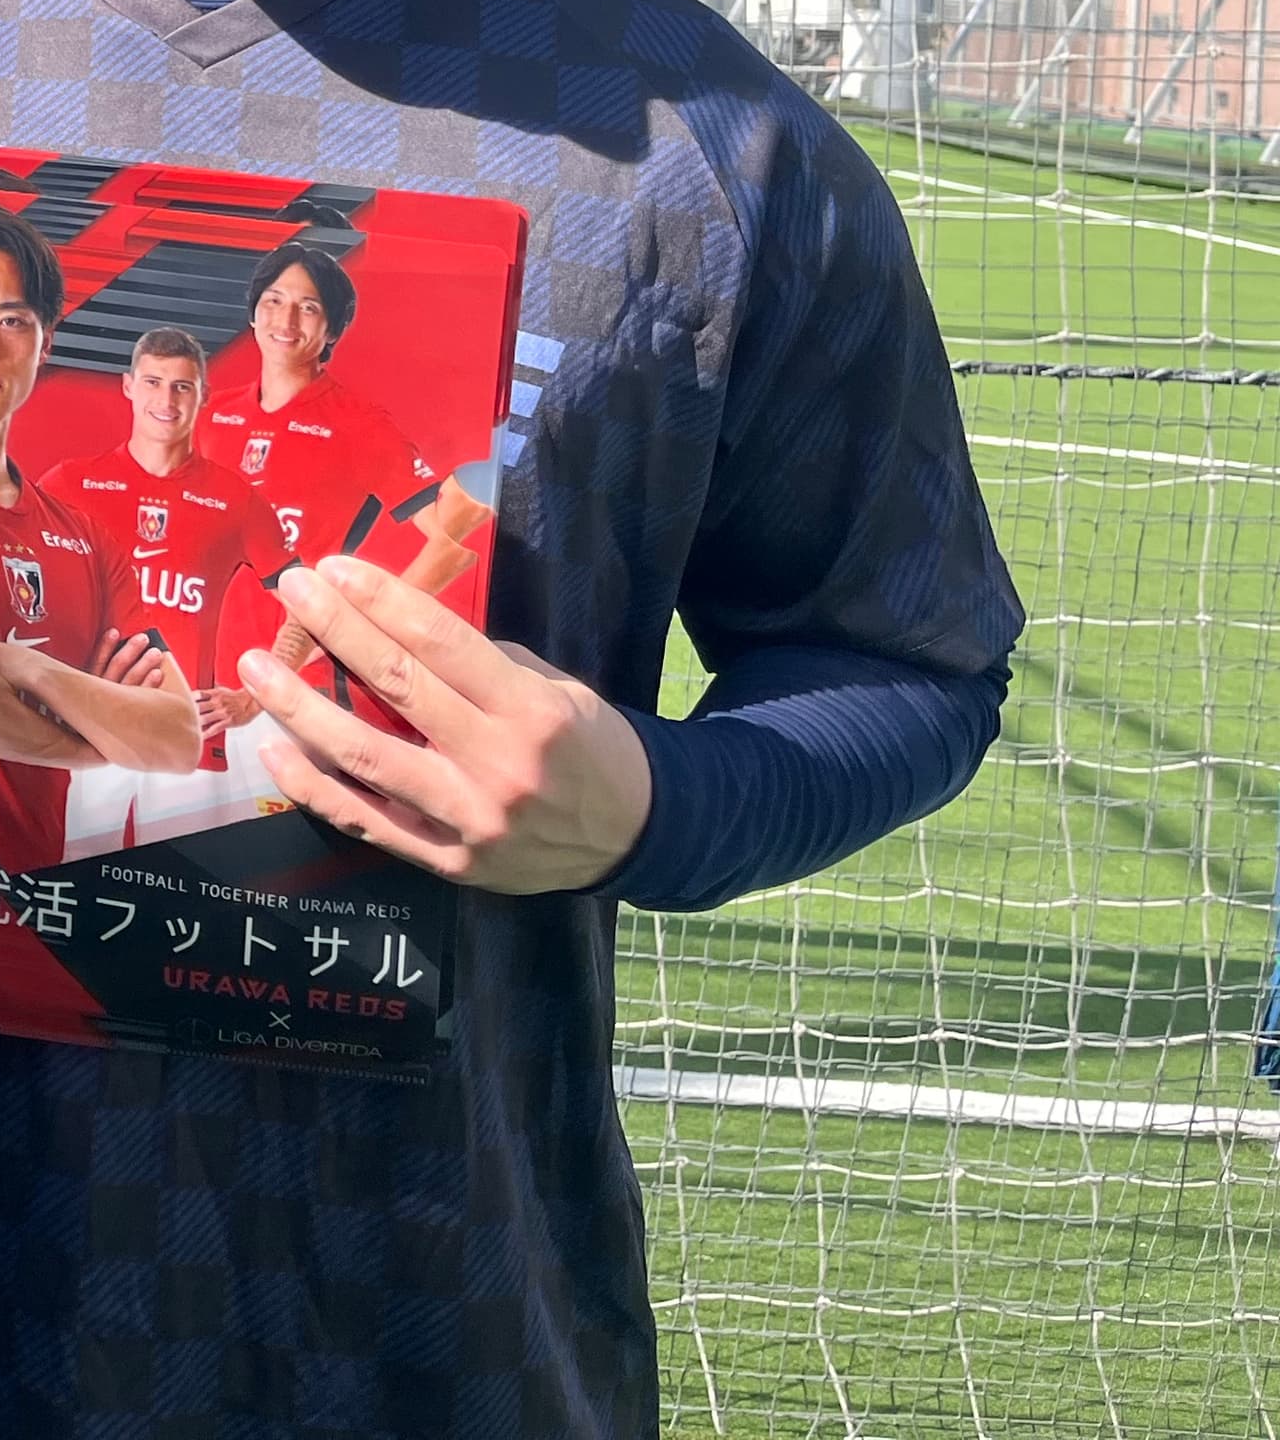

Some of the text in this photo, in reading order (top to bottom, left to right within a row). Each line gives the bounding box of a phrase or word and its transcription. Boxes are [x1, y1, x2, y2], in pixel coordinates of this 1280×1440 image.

[101, 864, 412, 921] FOOTBALL TOGETHER URAWA REDS
[163, 964, 407, 1021] URAWA REDS
